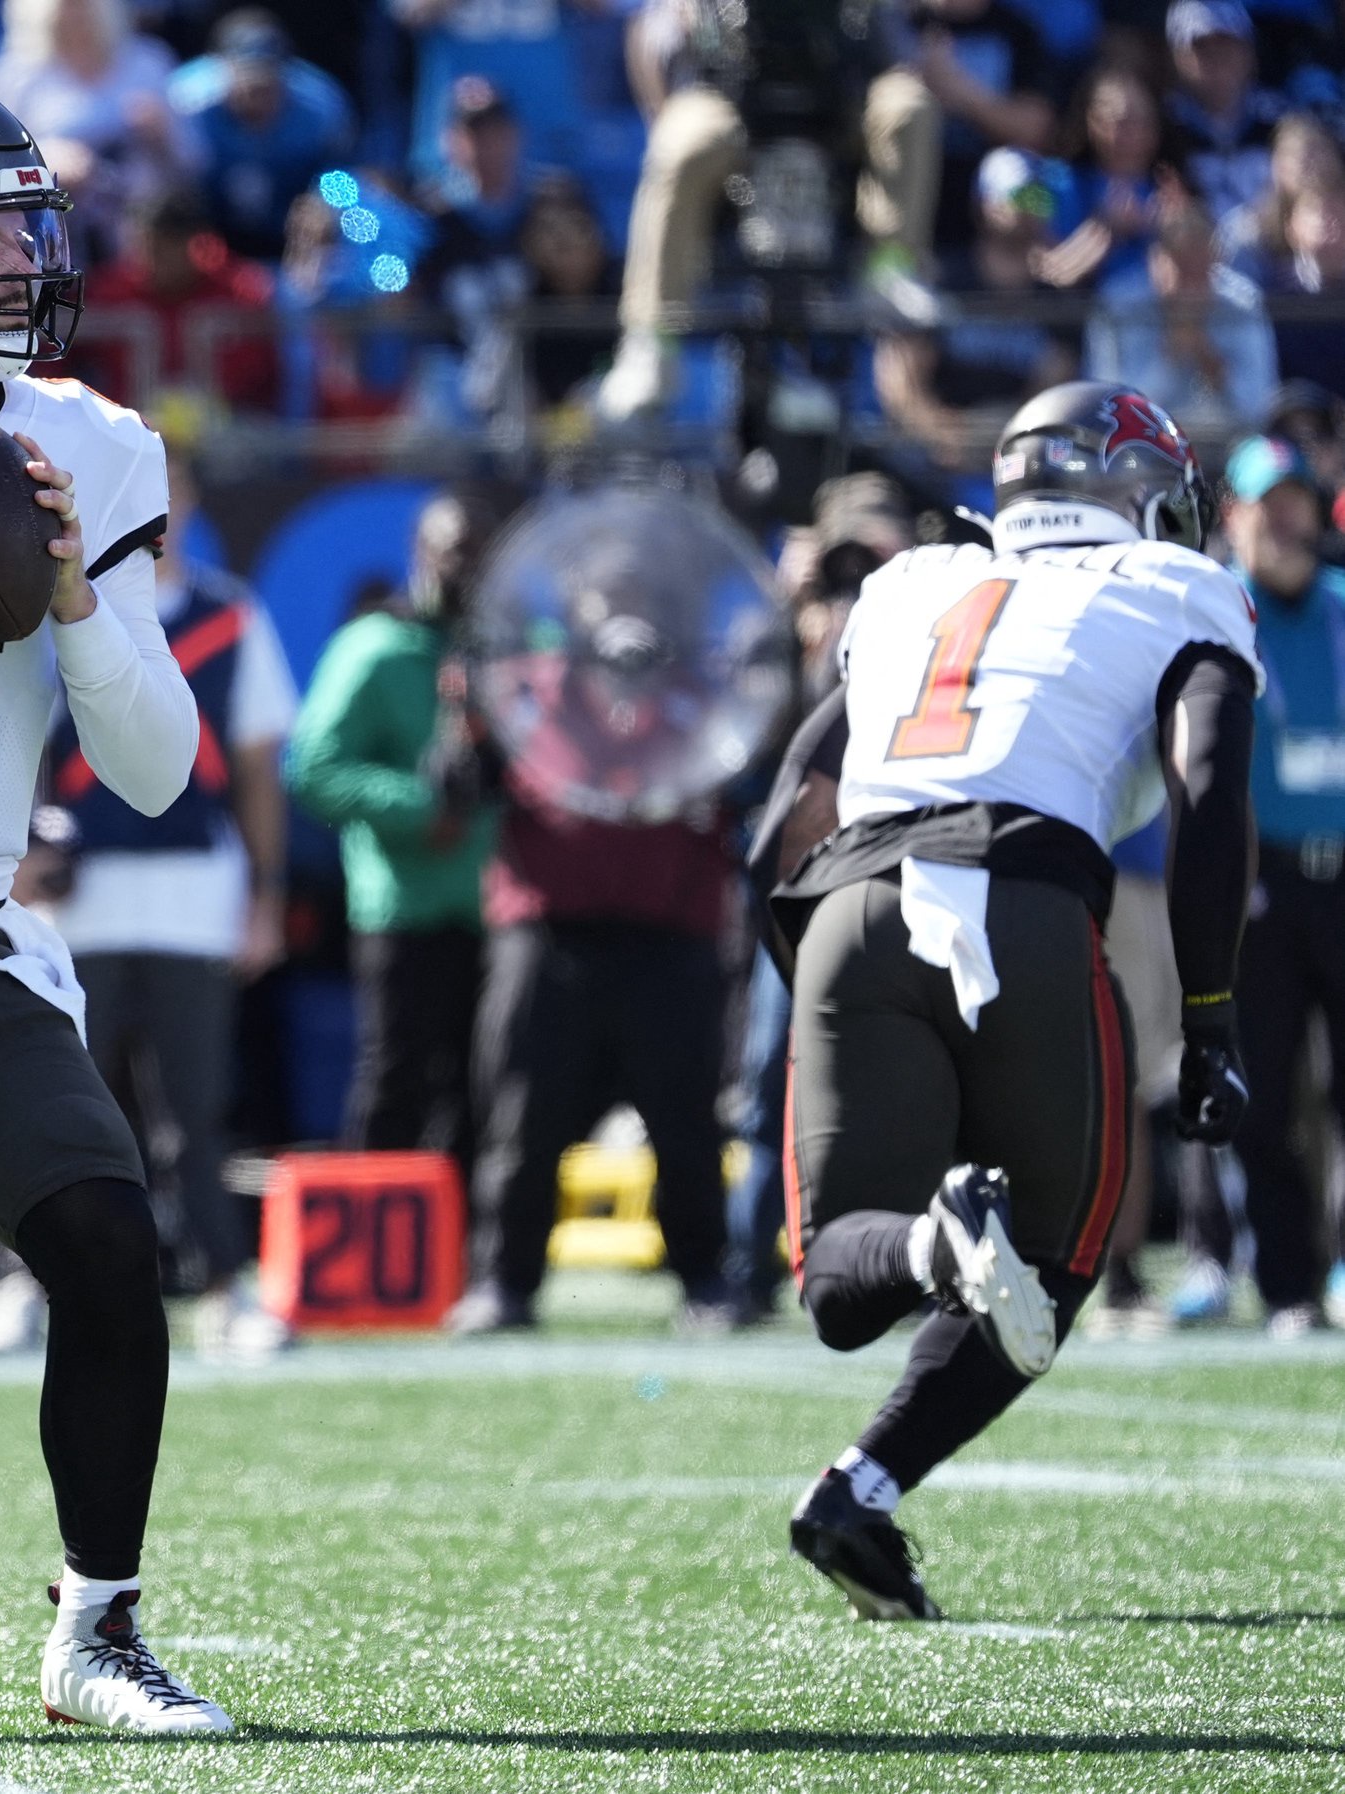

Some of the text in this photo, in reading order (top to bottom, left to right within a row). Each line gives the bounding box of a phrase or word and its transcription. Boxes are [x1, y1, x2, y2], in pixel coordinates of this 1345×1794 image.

[1040, 514, 1083, 528] HATE
[883, 578, 1019, 763] 1
[302, 1186, 427, 1310] 20
